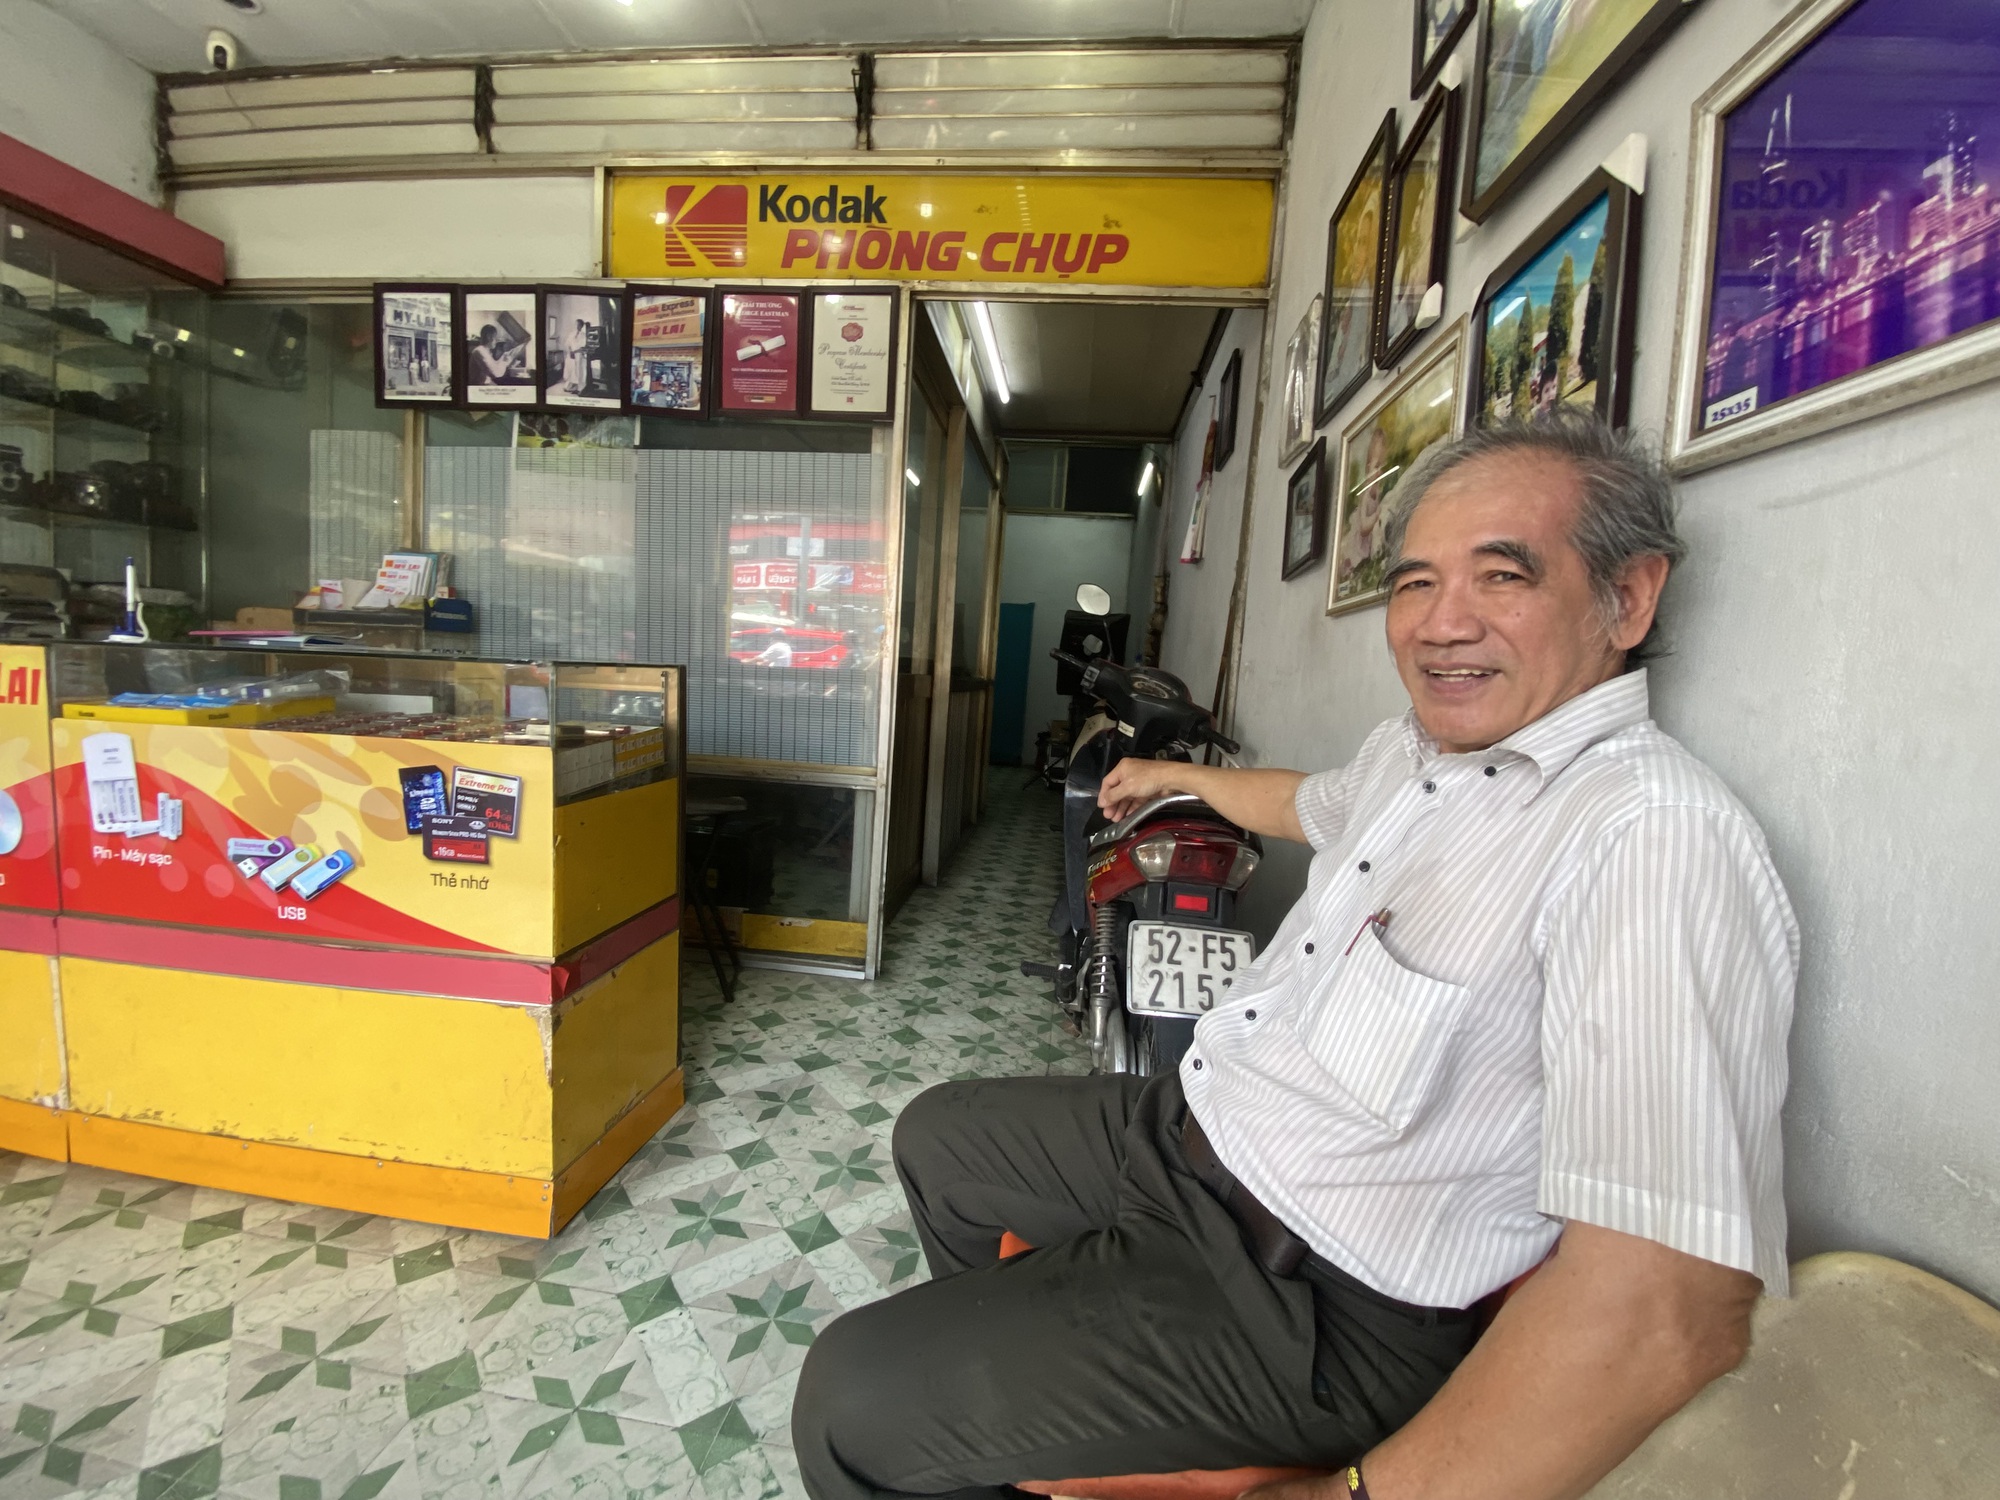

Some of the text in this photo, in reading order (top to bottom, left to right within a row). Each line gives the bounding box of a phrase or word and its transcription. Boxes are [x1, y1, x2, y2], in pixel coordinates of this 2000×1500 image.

[759, 184, 888, 224] Kodak
[780, 224, 1131, 279] PHÒNG CHỤP
[661, 299, 695, 311] Express
[1711, 397, 1751, 422] 25x35
[458, 778, 496, 791] Extreme
[497, 784, 514, 794] Pro
[431, 817, 454, 825] SONY
[92, 845, 113, 859] Pin
[121, 848, 147, 867] Máy
[148, 853, 173, 867] sạc
[430, 872, 490, 890] Thẻ nhớ
[277, 906, 307, 920] USB
[1148, 928, 1237, 971] 52-F5
